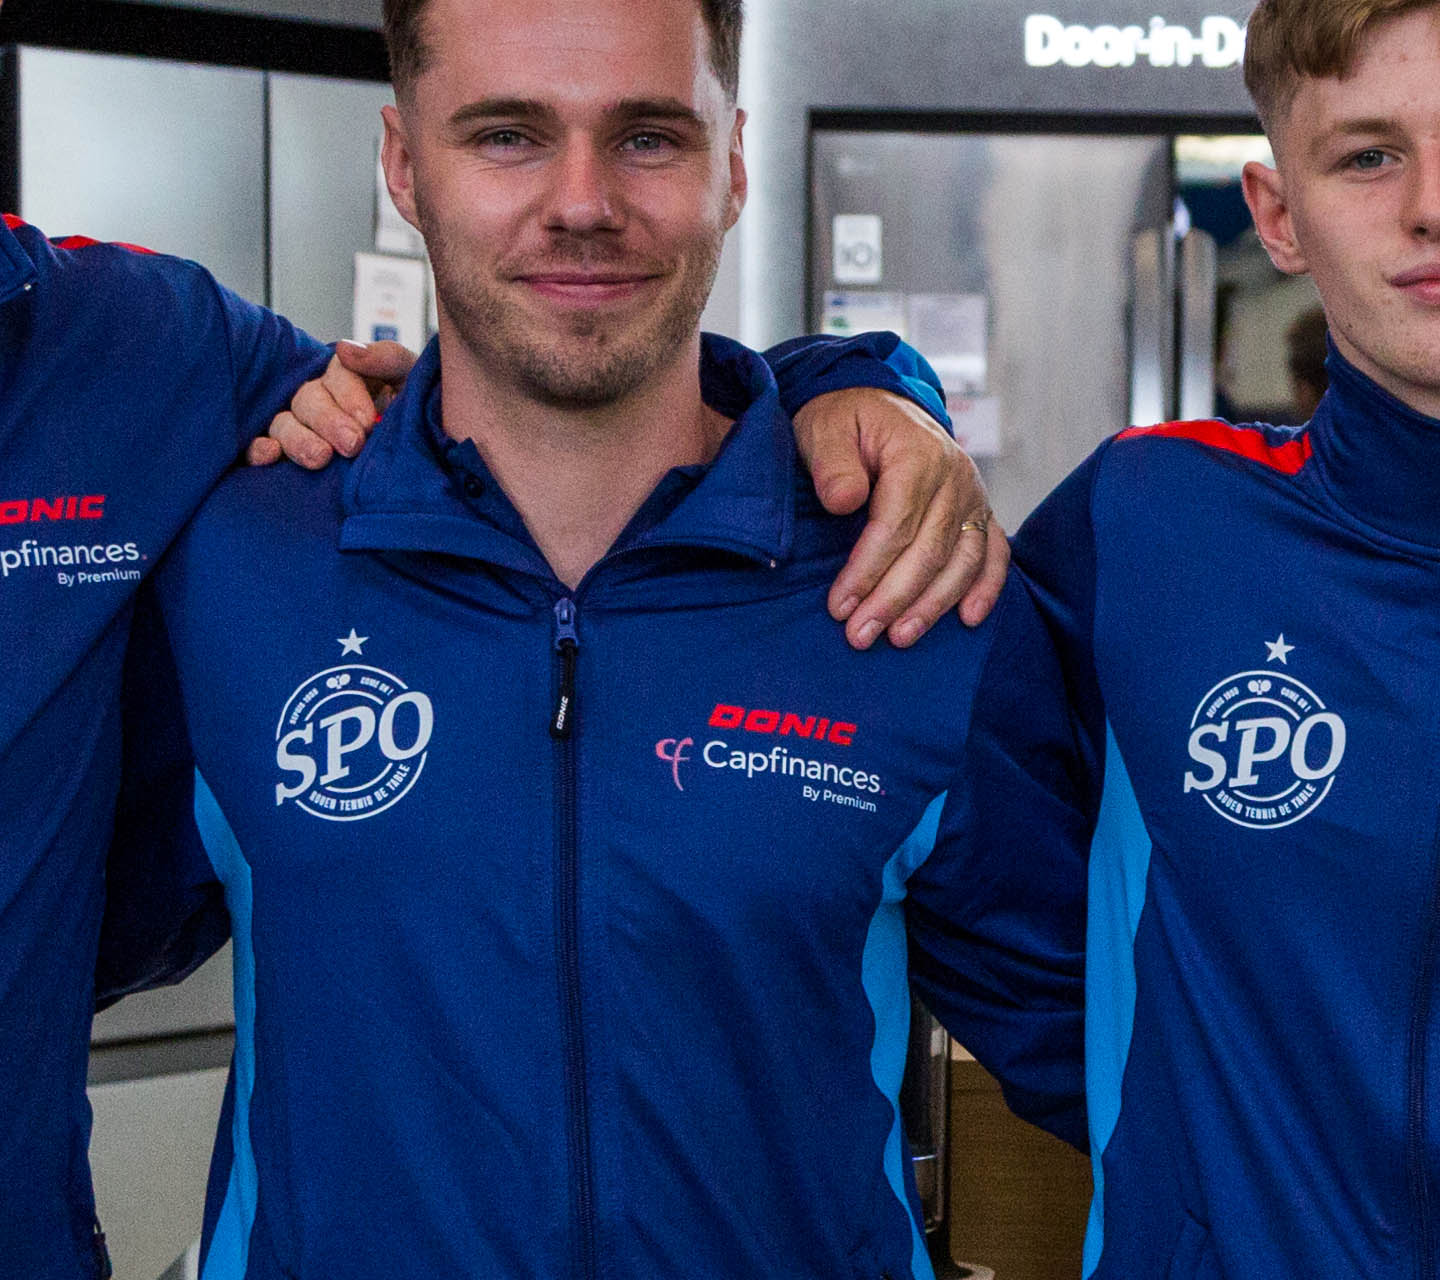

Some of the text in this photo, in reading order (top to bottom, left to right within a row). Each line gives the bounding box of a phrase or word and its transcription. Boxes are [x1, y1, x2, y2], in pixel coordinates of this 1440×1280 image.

[1024, 14, 1247, 67] Door-in-D
[57, 568, 140, 587] By Premium
[275, 691, 433, 806] SPO
[708, 704, 857, 746] DONIC
[1184, 712, 1346, 793] SPO
[803, 785, 877, 813] By Premium
